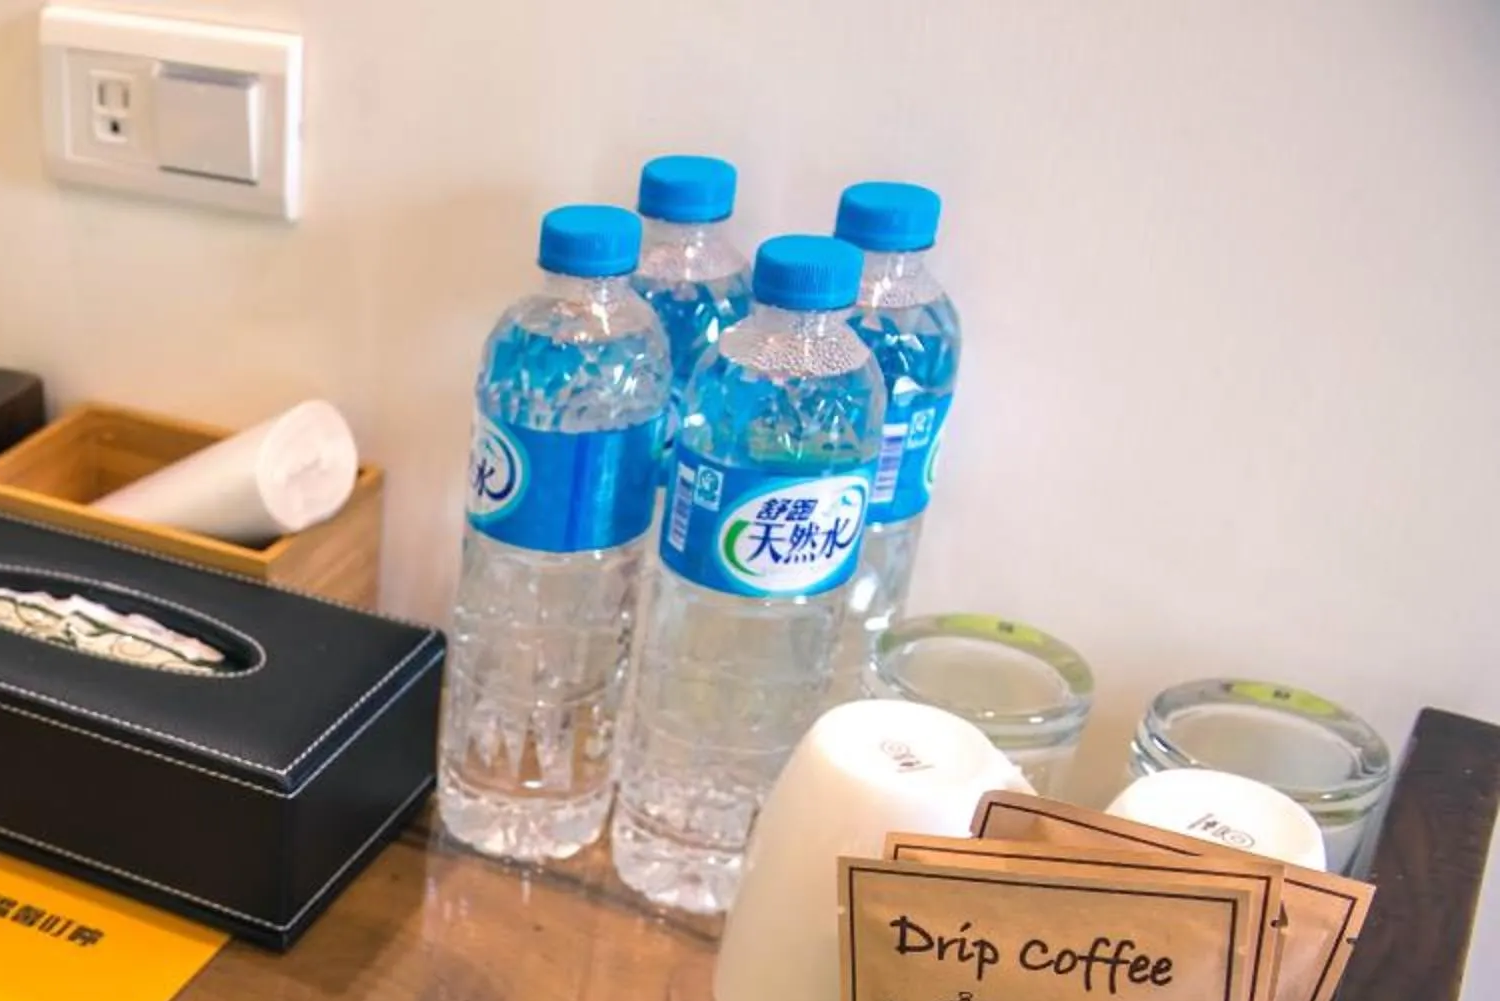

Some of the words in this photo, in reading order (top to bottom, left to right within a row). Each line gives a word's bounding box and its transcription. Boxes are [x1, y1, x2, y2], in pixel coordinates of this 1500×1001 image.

[747, 516, 850, 563] 天然水
[889, 915, 999, 981] Drip
[1019, 937, 1173, 994] Coffee
